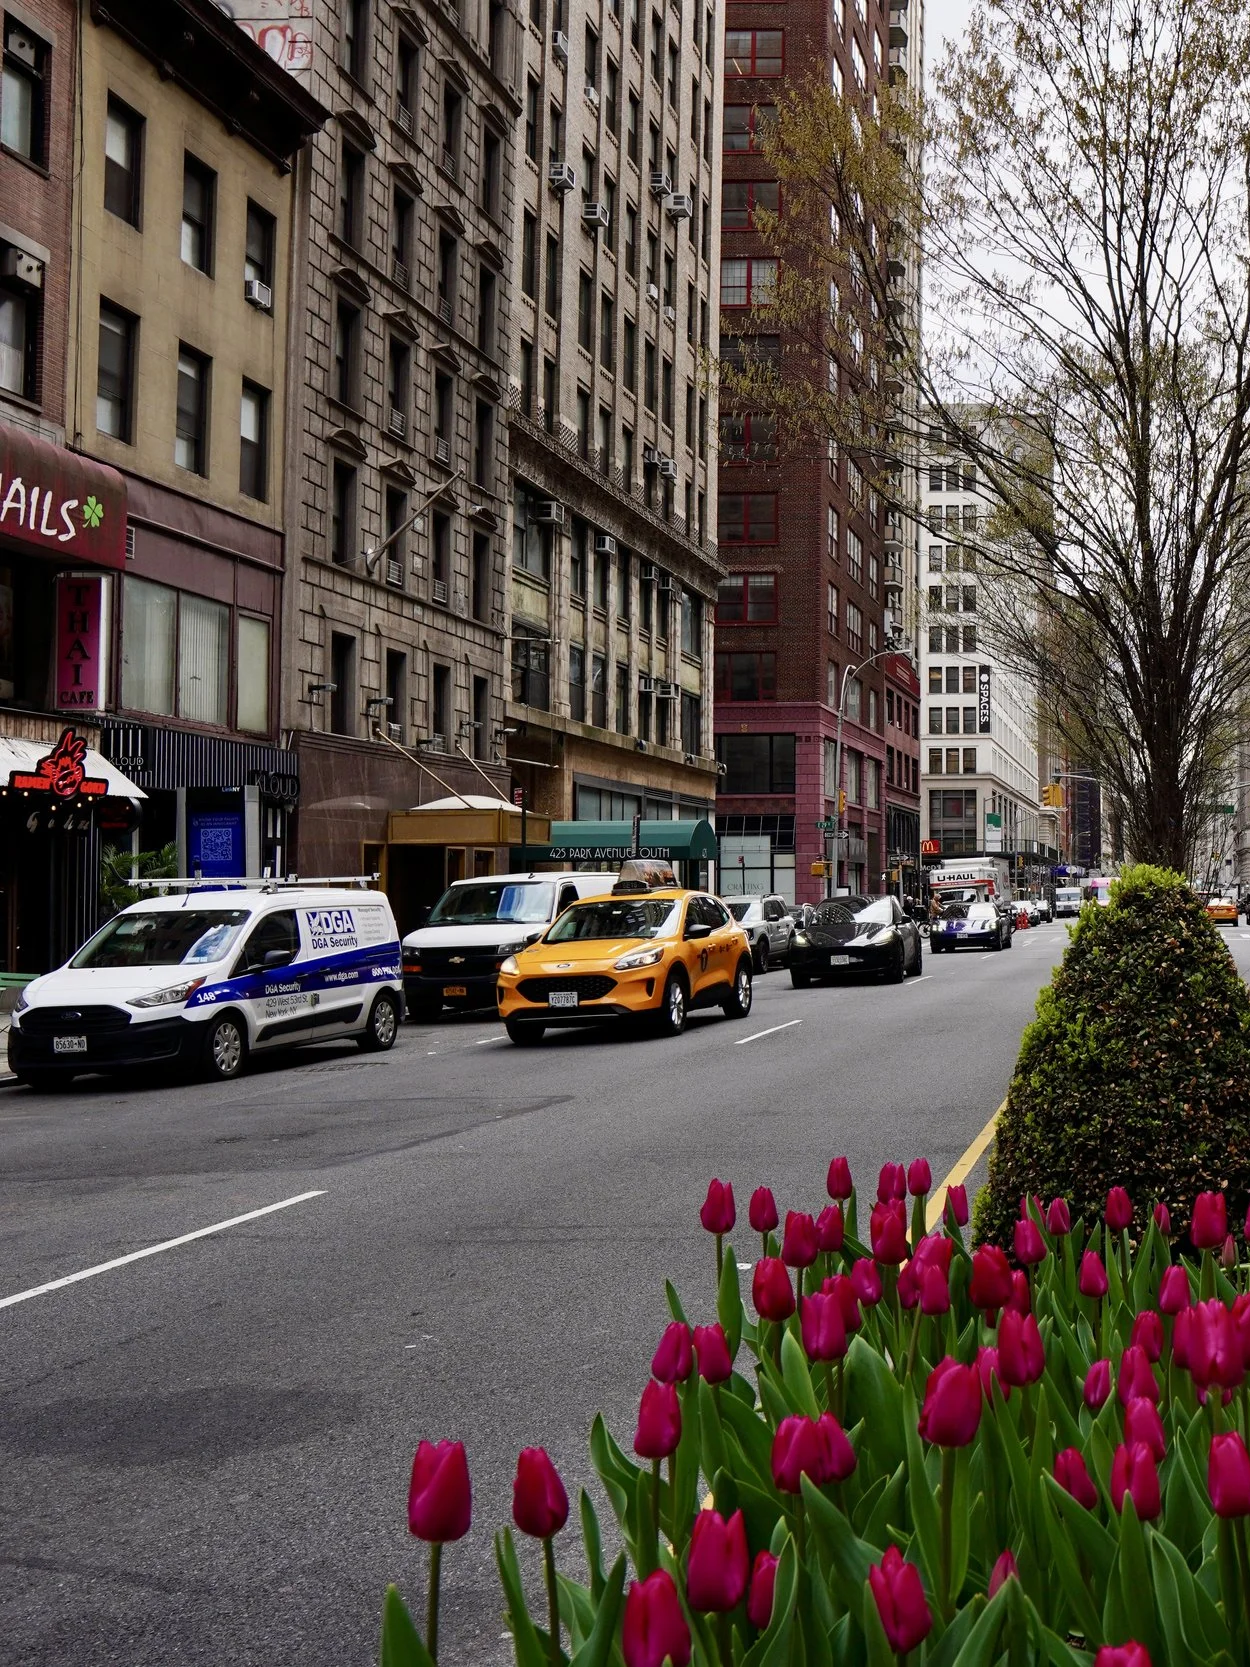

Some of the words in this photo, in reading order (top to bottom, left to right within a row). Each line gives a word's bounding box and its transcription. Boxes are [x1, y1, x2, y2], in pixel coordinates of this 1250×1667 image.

[0, 473, 79, 541] AILS
[66, 585, 91, 686] THAI
[60, 690, 94, 704] CAFE
[980, 684, 989, 725] SPACES.
[108, 757, 144, 766] KLOUD
[255, 775, 299, 797] KLOUD
[550, 848, 566, 858] 425
[569, 847, 592, 858] PARK
[594, 847, 632, 858] AVENUE
[638, 847, 670, 858] OUTH
[937, 873, 976, 881] U-HAUL
[727, 883, 764, 891] CRATING
[320, 910, 355, 934] DGA
[312, 938, 328, 949] DGA
[330, 935, 358, 949] Security
[324, 970, 358, 982] www.dga.com
[265, 984, 278, 995] DGA
[279, 982, 301, 993] Security
[196, 991, 216, 1003] 148
[265, 998, 277, 1008] 429
[277, 996, 290, 1006] West
[265, 1009, 277, 1019] New
[290, 1006, 298, 1016] NY
